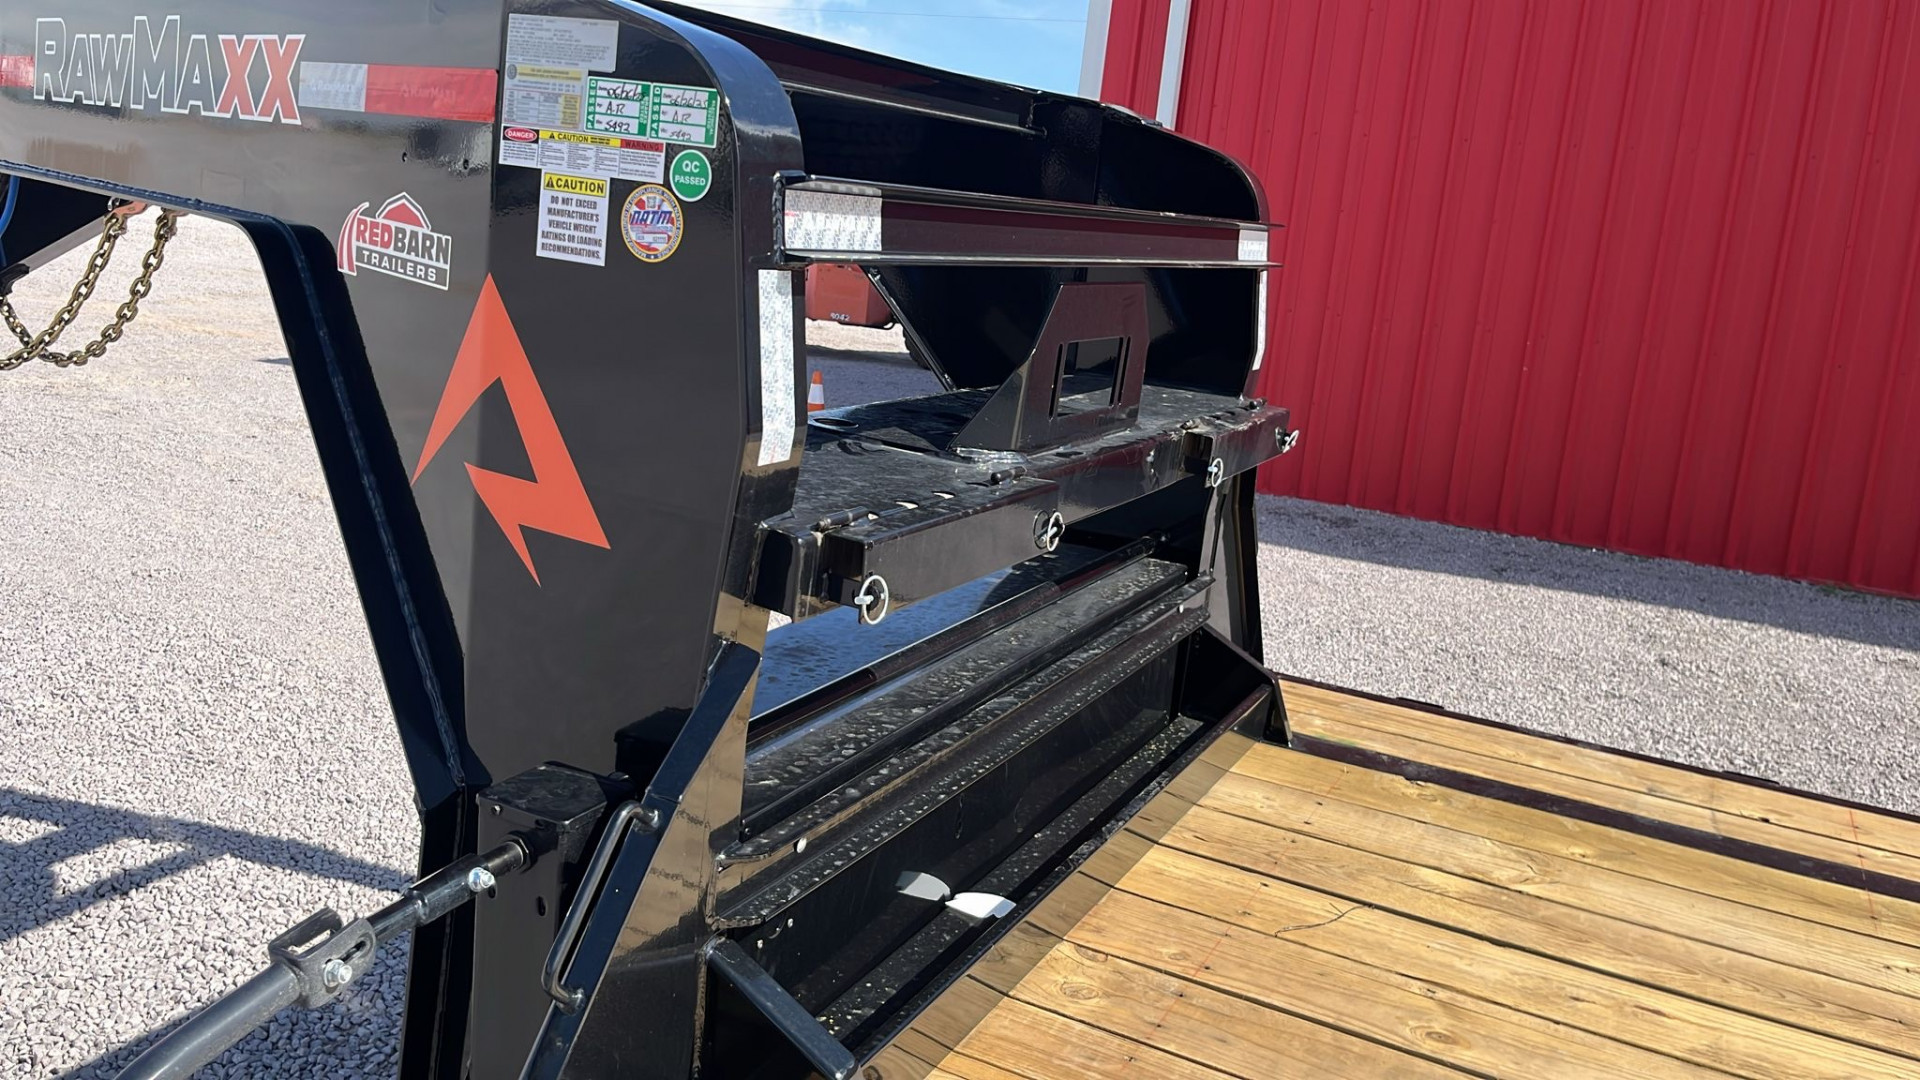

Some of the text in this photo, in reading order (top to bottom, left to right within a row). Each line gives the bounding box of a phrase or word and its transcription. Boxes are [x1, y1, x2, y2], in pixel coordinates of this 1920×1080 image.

[587, 80, 597, 129] PASSED
[651, 87, 660, 137] PASSED
[507, 131, 534, 139] DANGER
[557, 132, 589, 143] CAUTION
[625, 140, 660, 150] WARNING
[682, 160, 700, 173] QC
[555, 178, 605, 194] CAUTION
[674, 175, 706, 186] PASSED
[551, 195, 598, 210] DO NOT EXCEED
[547, 207, 600, 222] MANUFACTURER'S
[548, 219, 597, 235] VEHICLE WEIGHT
[541, 230, 603, 248] RATINGS OR LOADING
[541, 242, 601, 259] RECOMMENDATIONS.
[362, 250, 437, 282] TRAILERS
